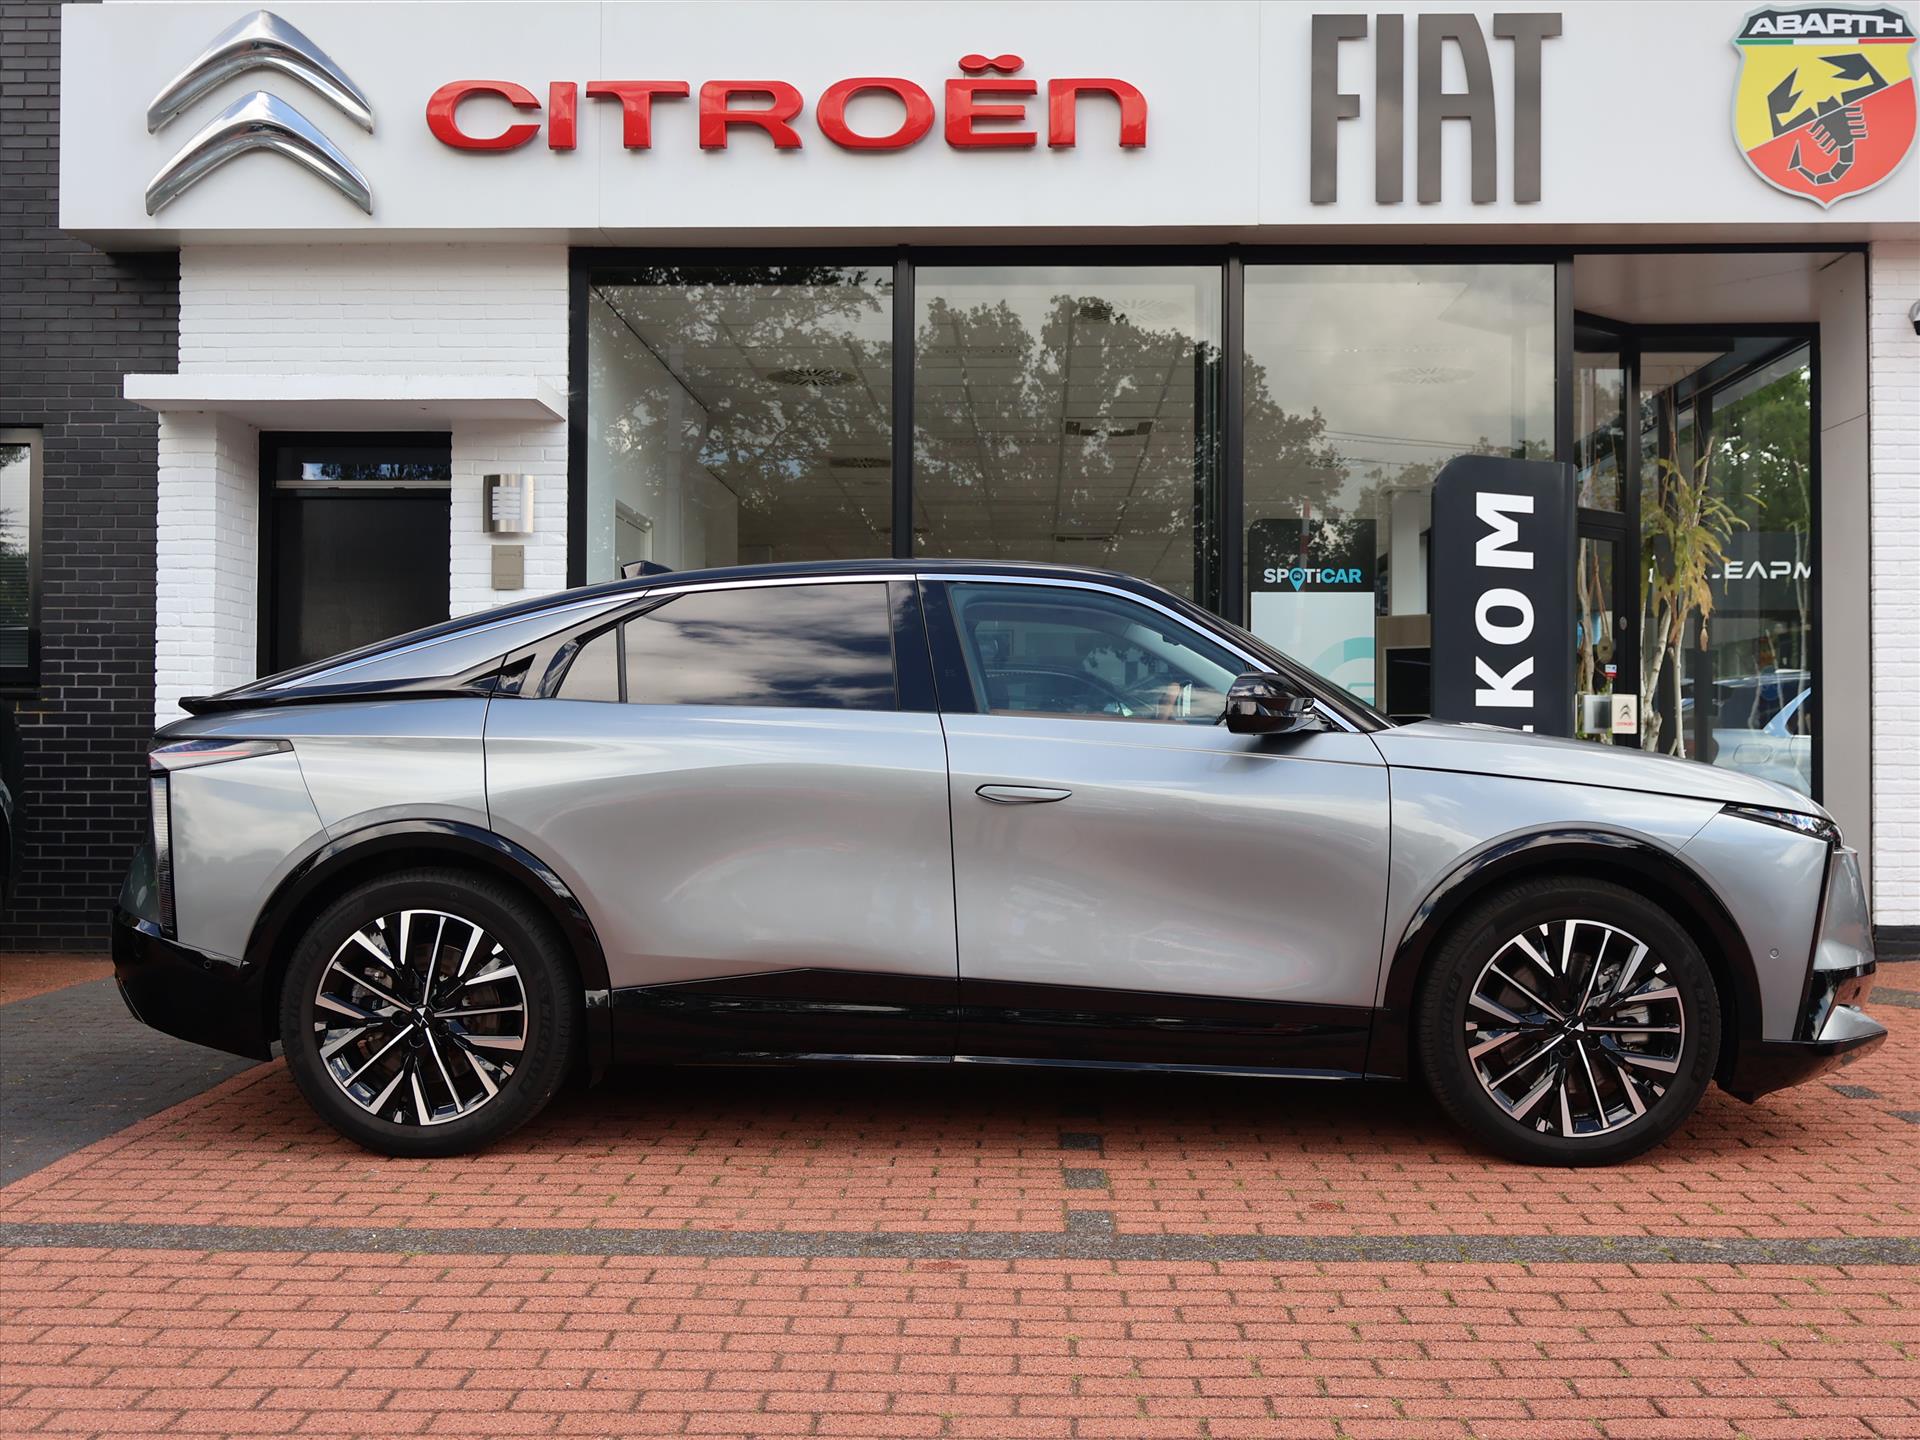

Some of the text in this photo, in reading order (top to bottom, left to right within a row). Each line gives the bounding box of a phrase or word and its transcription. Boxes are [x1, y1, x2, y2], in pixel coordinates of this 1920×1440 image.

[1748, 13, 1904, 35] ABARTH
[426, 54, 1149, 152] CITROËN
[1310, 13, 1563, 204] FIAT
[1475, 491, 1535, 733] KOM
